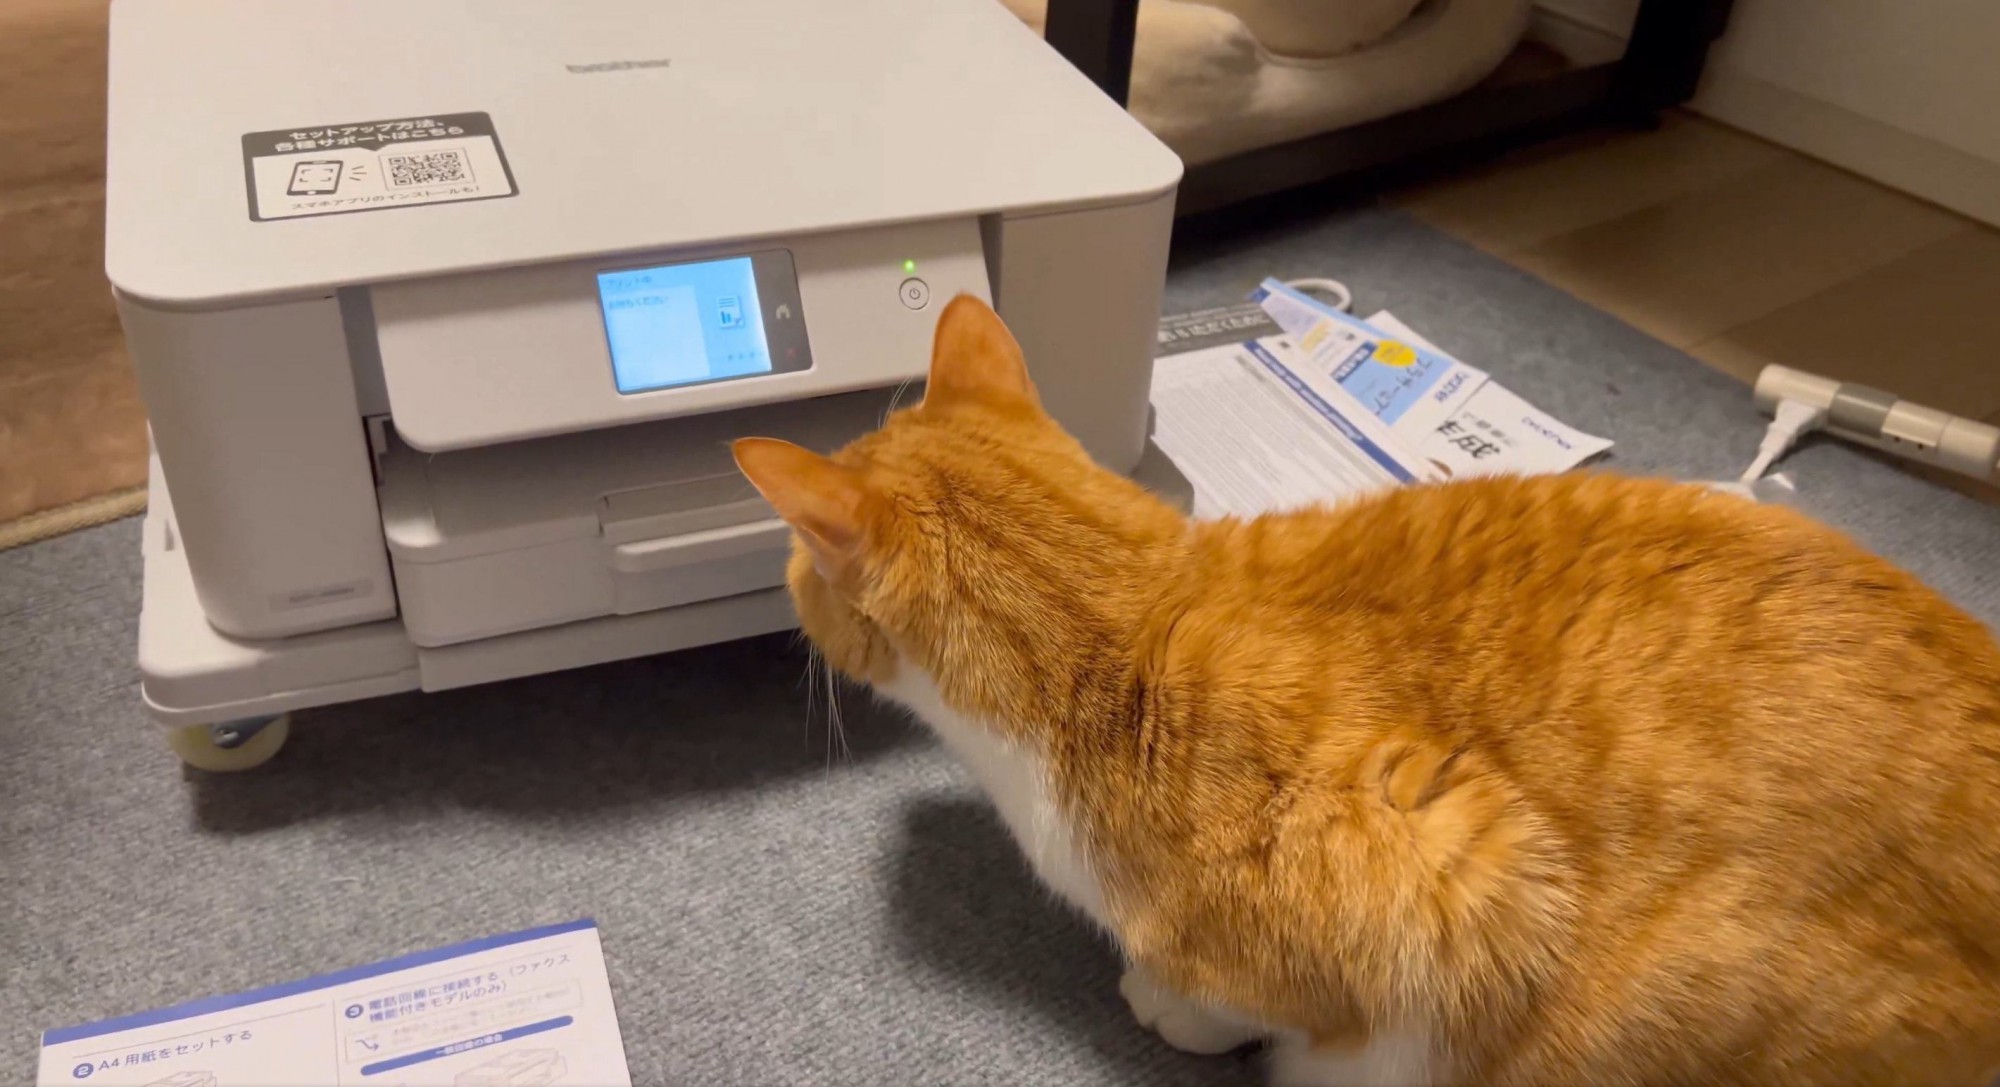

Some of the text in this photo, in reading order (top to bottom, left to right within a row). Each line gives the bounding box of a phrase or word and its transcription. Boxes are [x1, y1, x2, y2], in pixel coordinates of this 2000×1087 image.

[274, 126, 464, 152] 各種サポートはこちら
[289, 118, 444, 141] セットアップ方法、
[98, 1058, 120, 1071] A4
[124, 1030, 253, 1067] 用紙をセットする
